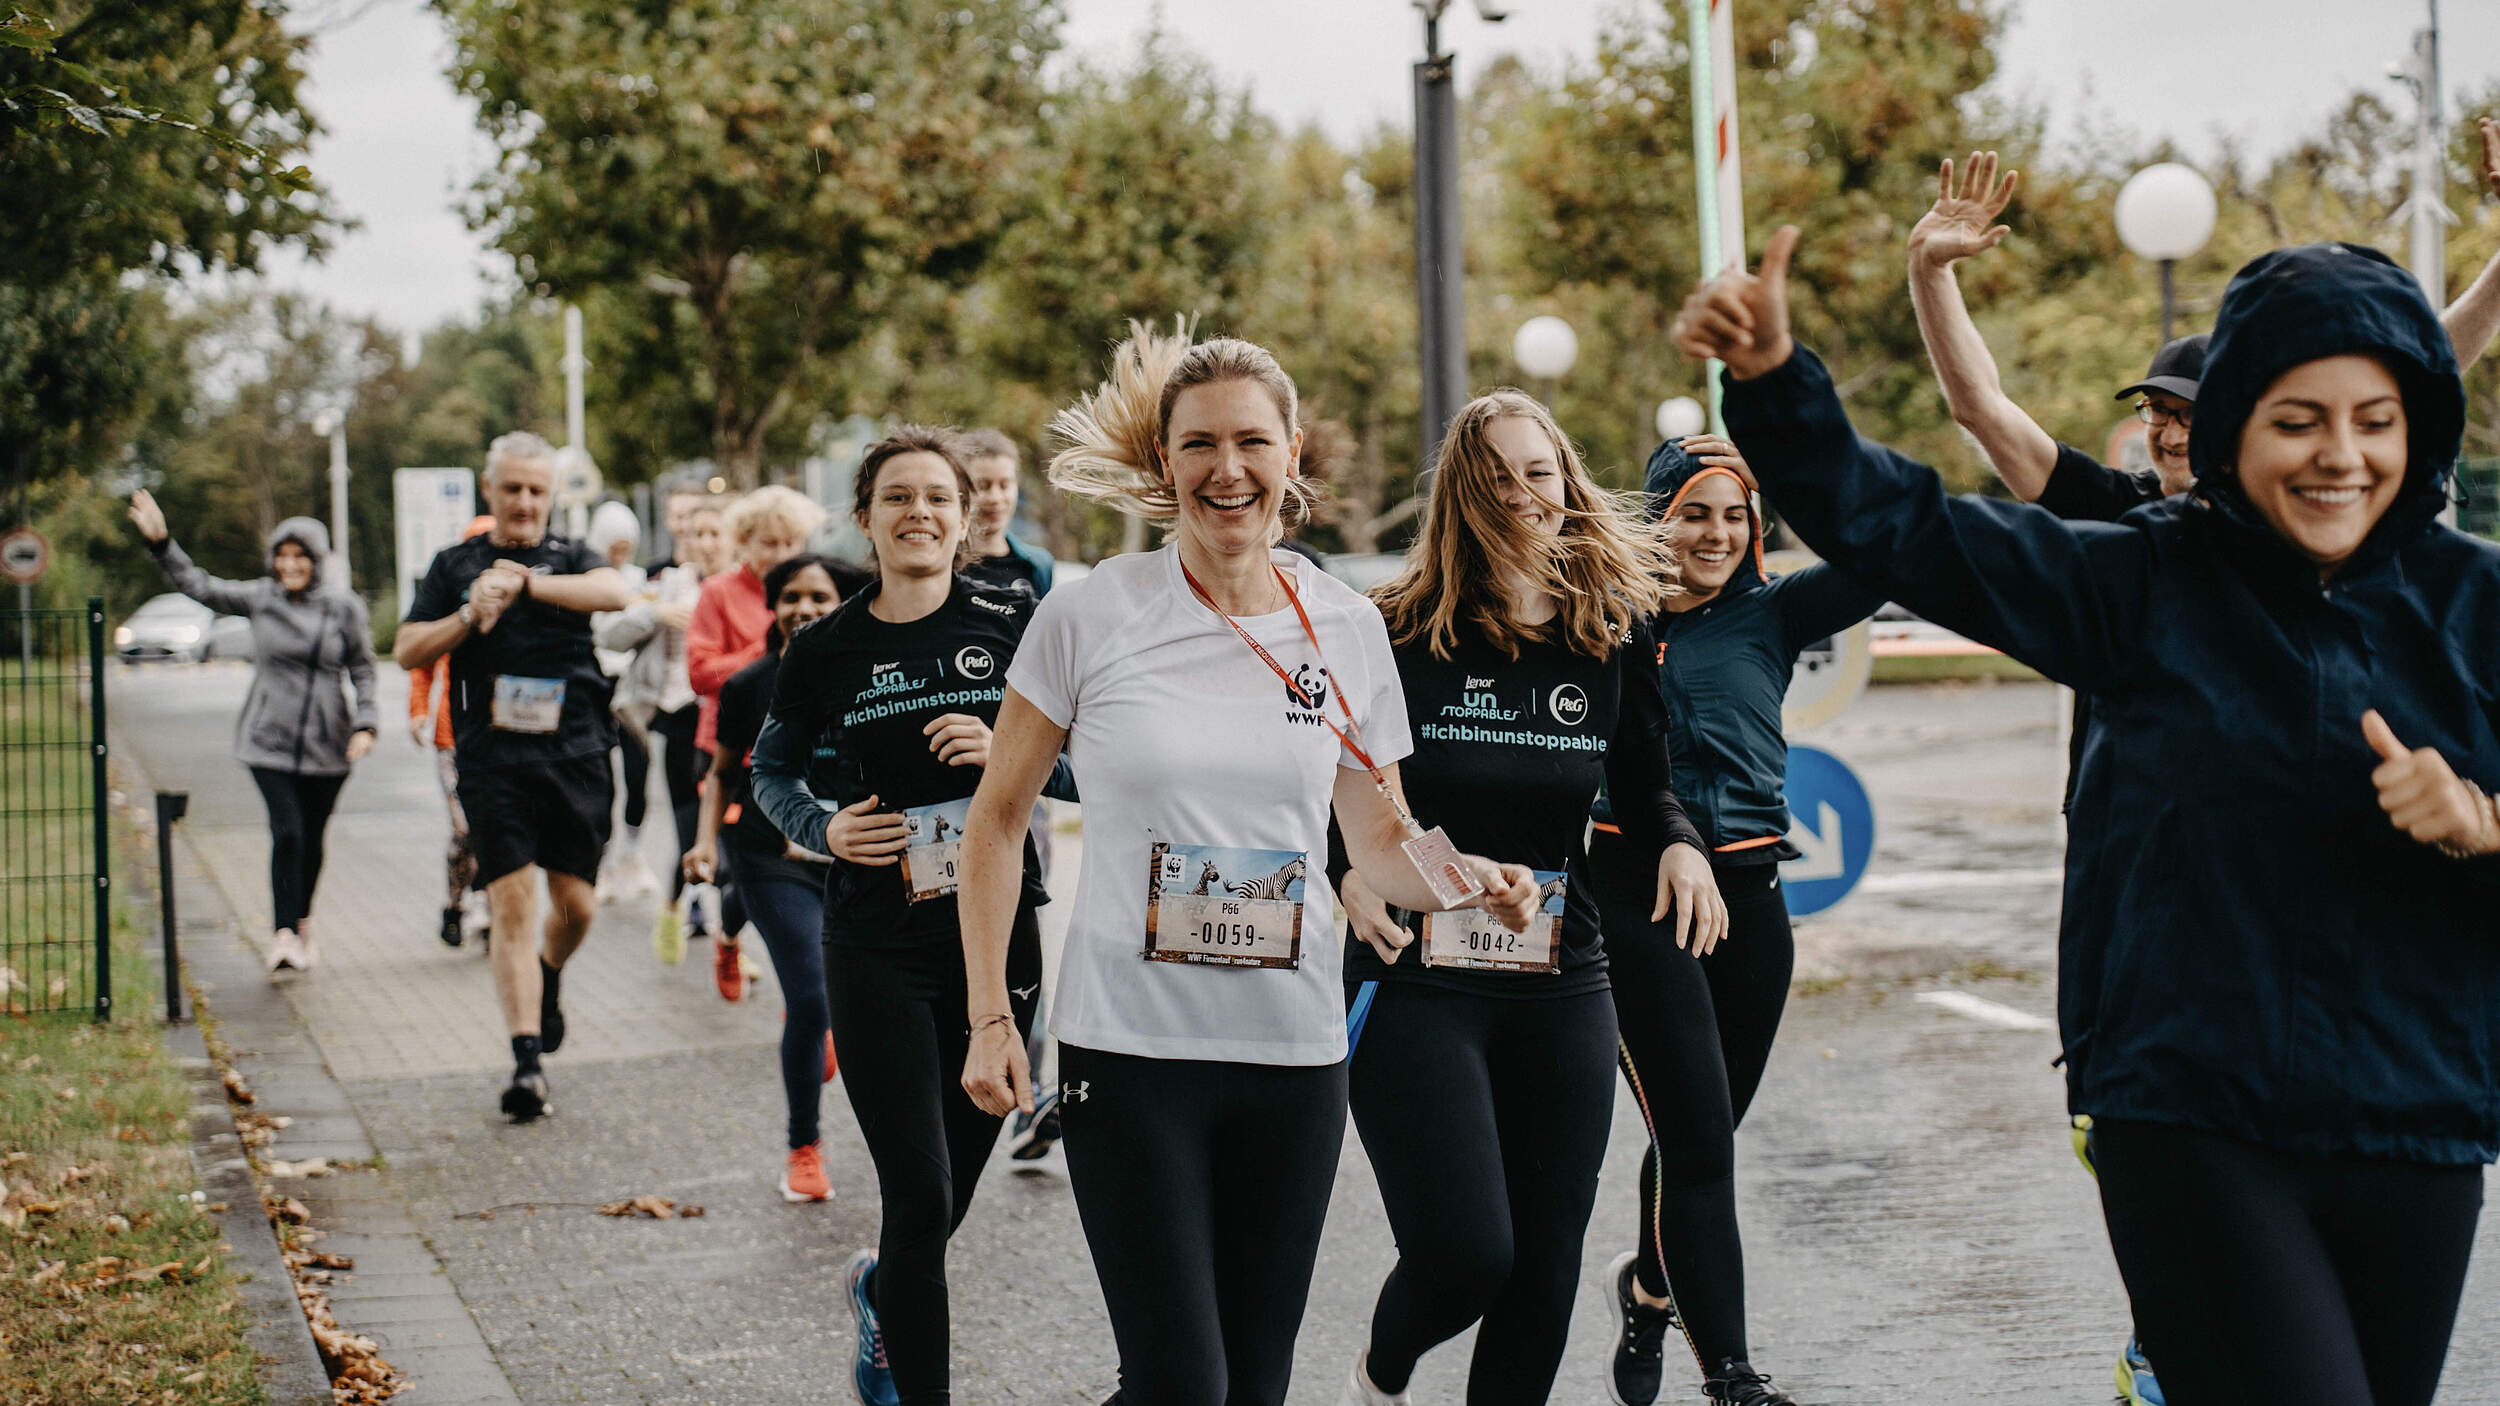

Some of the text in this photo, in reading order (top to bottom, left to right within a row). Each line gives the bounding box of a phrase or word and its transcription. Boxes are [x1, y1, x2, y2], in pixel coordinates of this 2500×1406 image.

[971, 596, 1007, 613] CRAFT
[965, 655, 988, 669] P&G
[1256, 645, 1280, 672] REQUIRED
[873, 661, 900, 675] Lenor
[855, 678, 929, 703] STOPPABLES
[1465, 675, 1495, 690] Lenor
[843, 686, 1005, 728] #ichbinunstoppabl
[1558, 697, 1584, 712] P&G
[1285, 712, 1325, 727] WWF
[1440, 705, 1520, 721] STOPPABLES
[1421, 723, 1607, 752] #ichbinunstoppable
[1222, 902, 1239, 915] P&G
[1190, 922, 1265, 946] -0059-
[1460, 931, 1524, 953] -0042-
[1187, 953, 1202, 962] WWF
